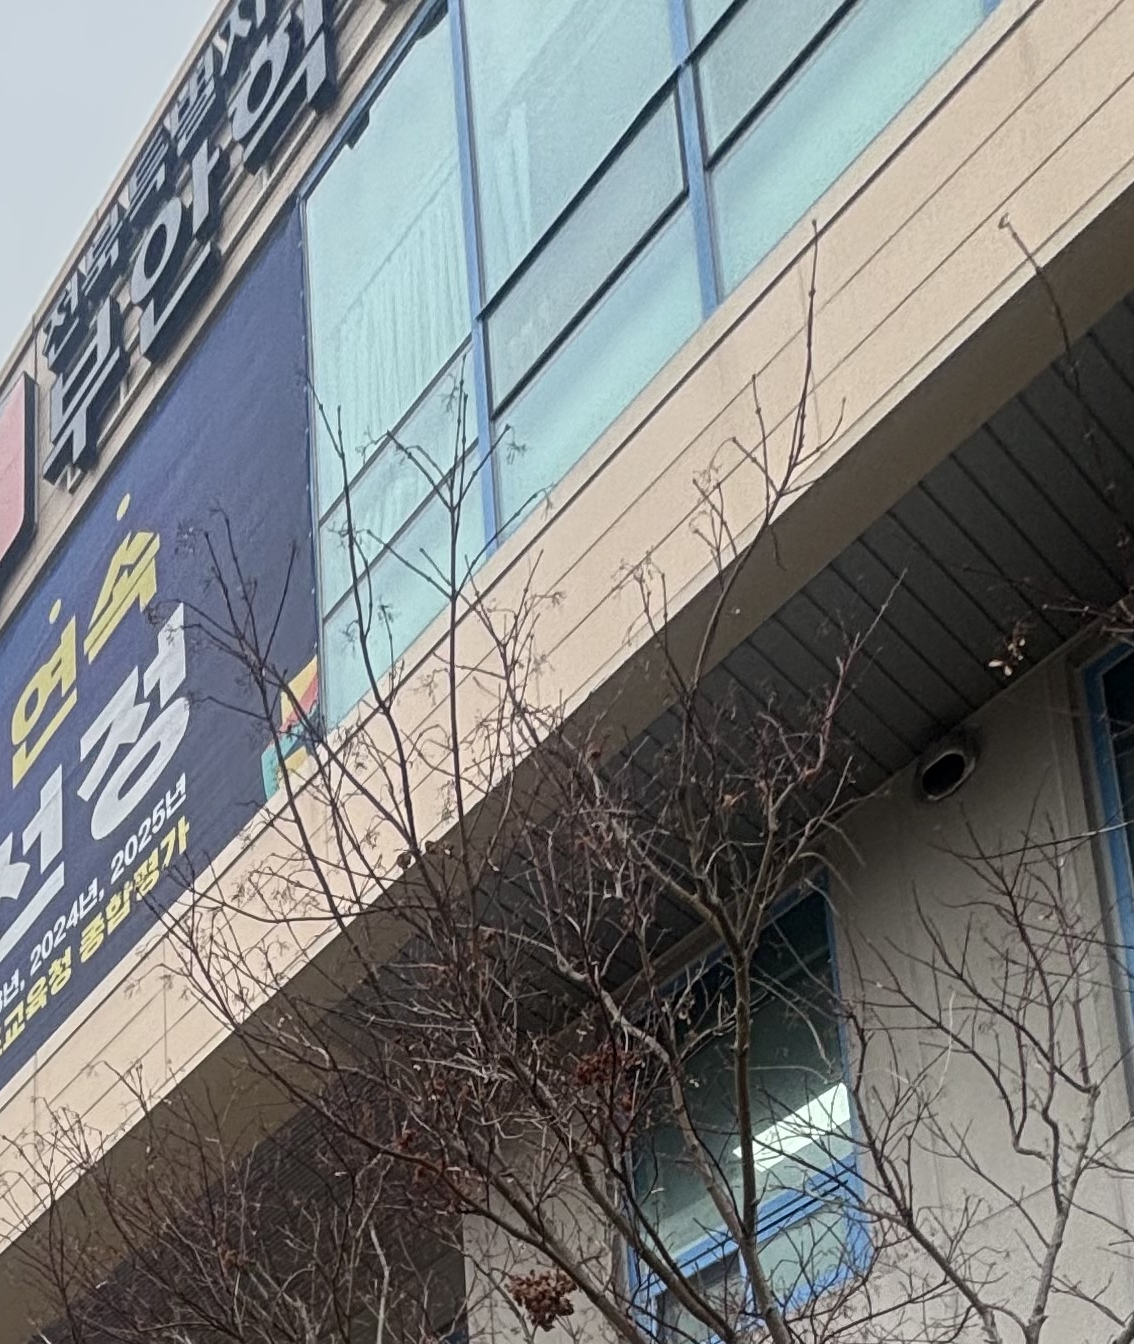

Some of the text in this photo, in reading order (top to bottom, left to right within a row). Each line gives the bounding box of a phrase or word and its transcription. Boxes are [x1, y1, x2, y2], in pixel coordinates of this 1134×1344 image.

[10, 532, 160, 788] 연속
[30, 877, 105, 973] 2024년,
[112, 773, 187, 883] 2025년
[80, 815, 191, 963] 종합평가
